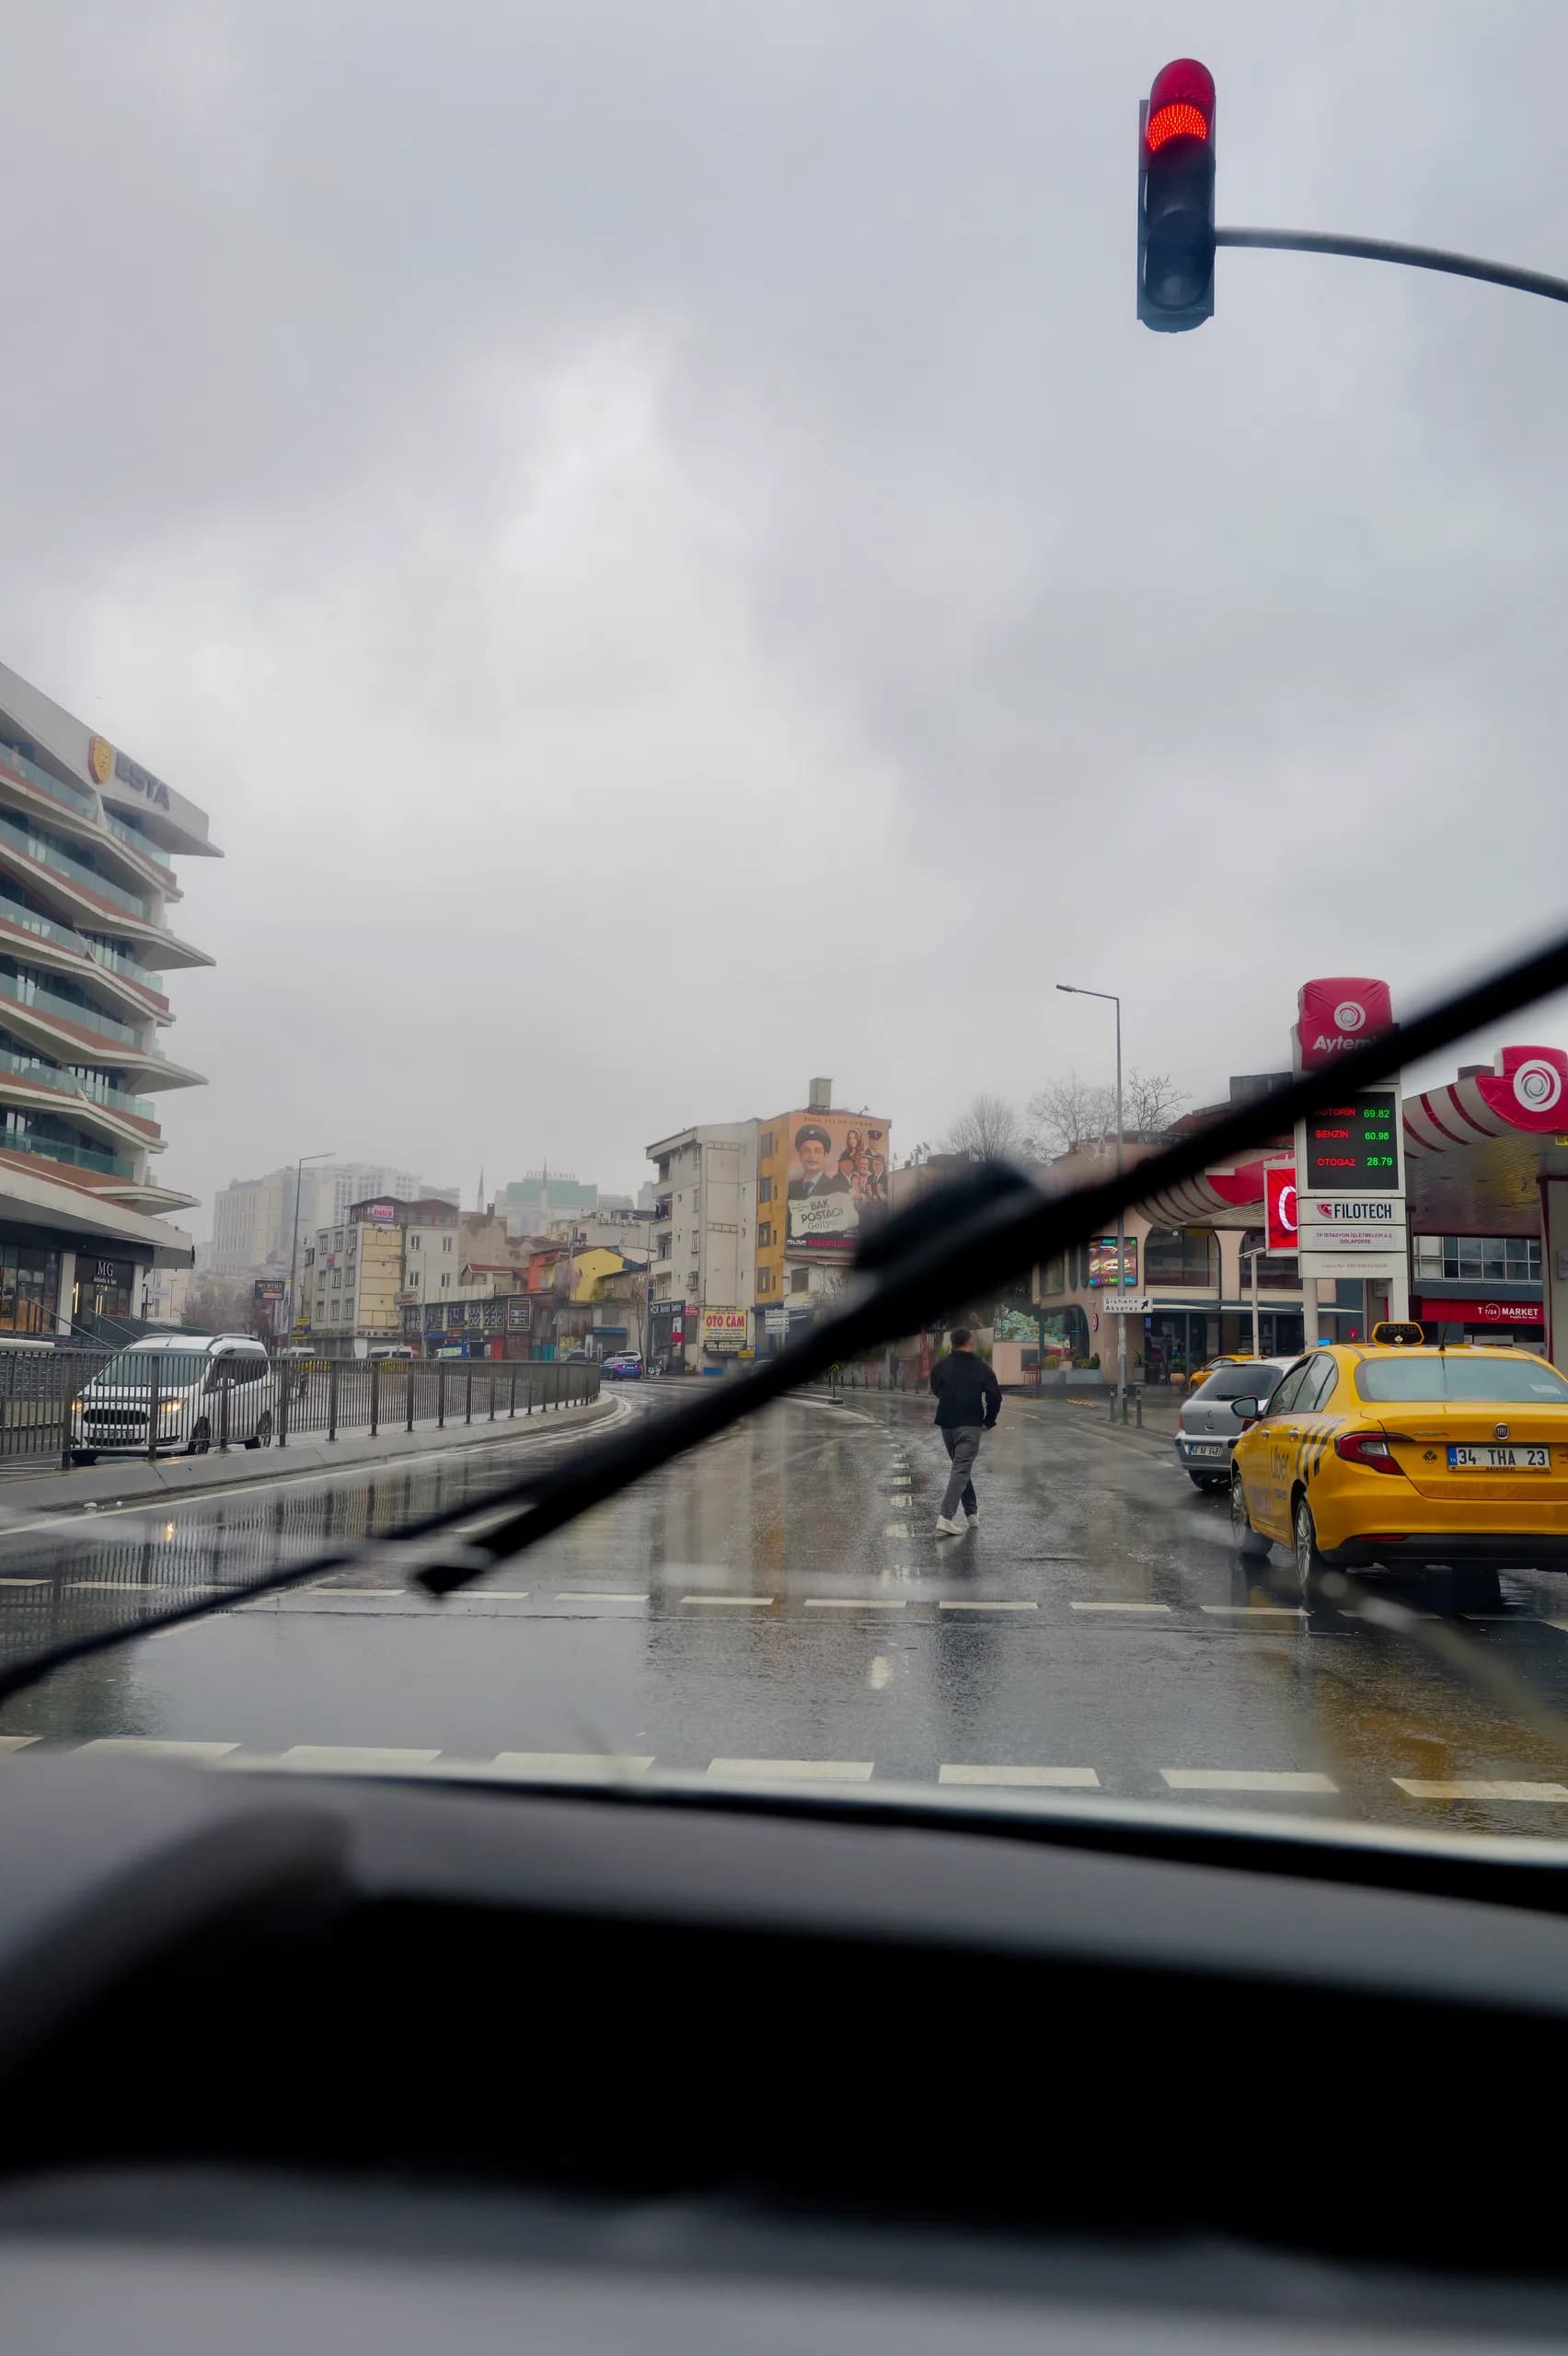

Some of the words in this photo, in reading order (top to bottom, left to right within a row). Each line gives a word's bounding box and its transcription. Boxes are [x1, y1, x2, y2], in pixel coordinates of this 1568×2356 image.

[1364, 1109, 1389, 1118] 69.82
[1316, 1129, 1349, 1138] BENZİN
[1366, 1132, 1389, 1140] 60.98
[1318, 1158, 1356, 1167] OTOGAZ
[1367, 1157, 1393, 1166] 28.79
[810, 1198, 830, 1210] BAK
[801, 1207, 844, 1223] POSTACI
[1334, 1204, 1392, 1219] FILOTECH
[98, 1260, 114, 1276] MG
[1502, 1308, 1539, 1316] MARKET
[706, 1315, 723, 1327] OTO
[726, 1315, 744, 1328] CAM
[1458, 1449, 1477, 1465] 34
[1487, 1449, 1516, 1466] THA
[1527, 1449, 1546, 1466] 23
